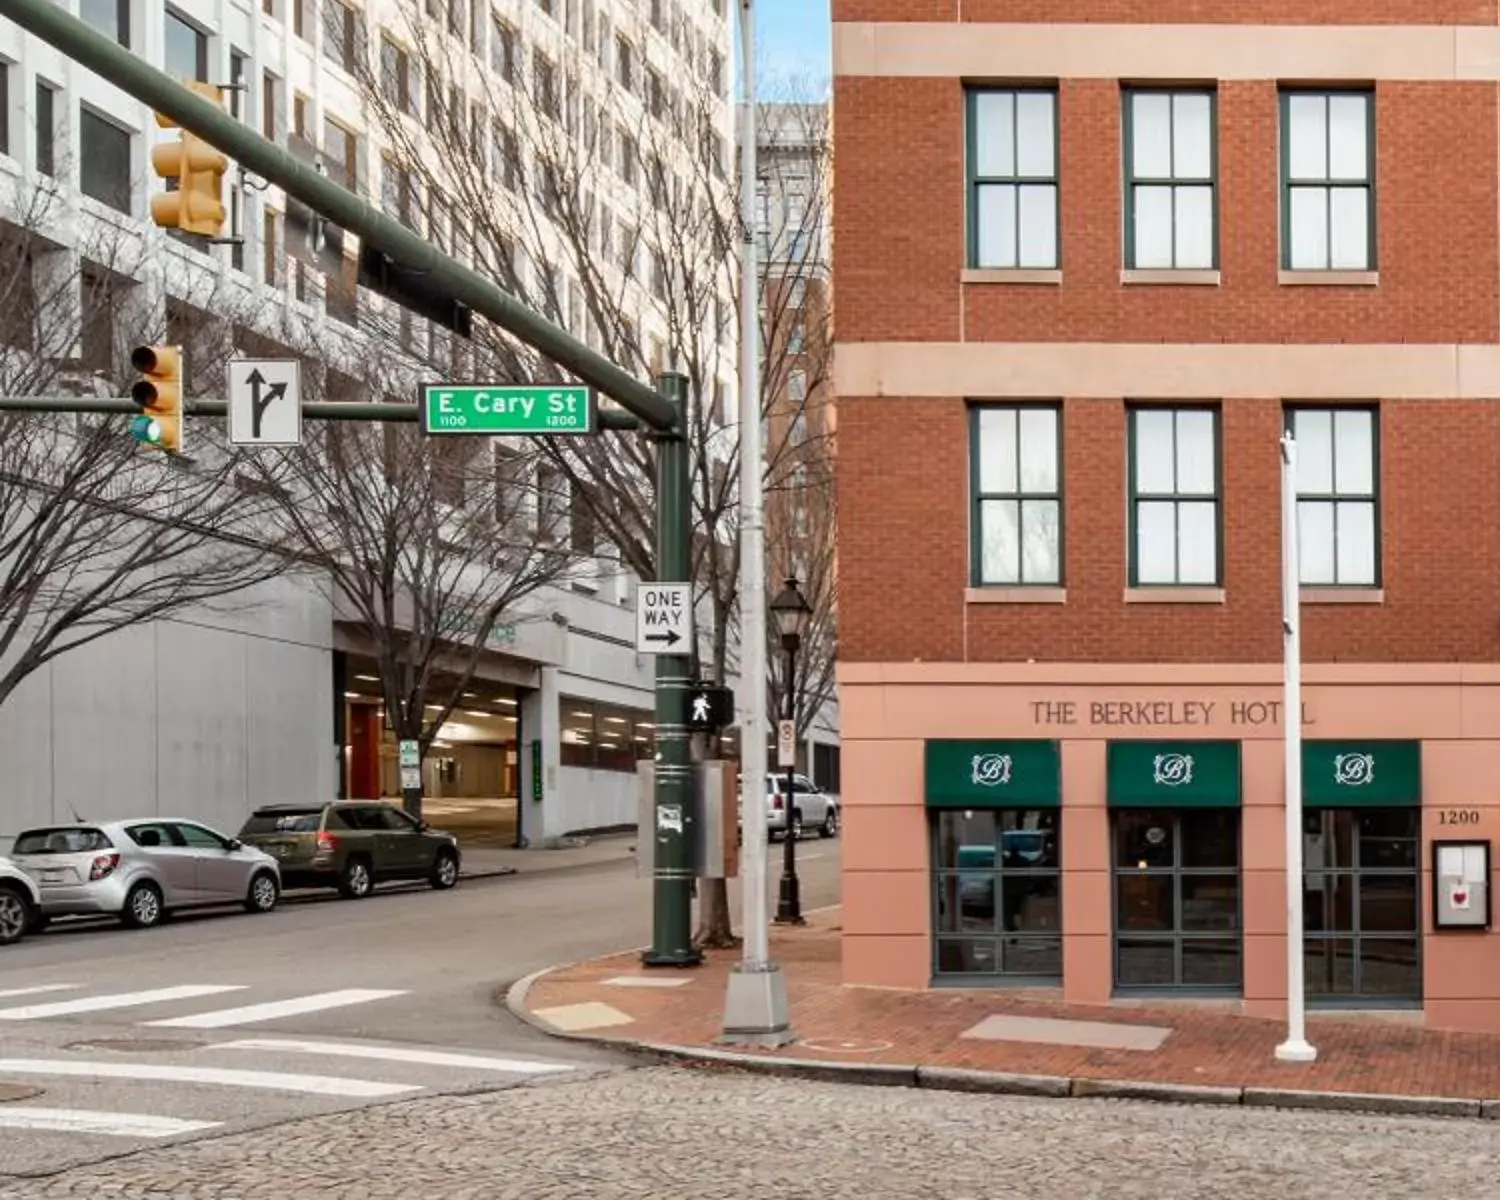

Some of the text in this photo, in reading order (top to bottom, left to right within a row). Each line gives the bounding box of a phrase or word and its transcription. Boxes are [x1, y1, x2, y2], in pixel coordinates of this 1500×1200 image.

[439, 392, 577, 418] E. Cary St
[440, 415, 467, 426] 1100
[546, 415, 577, 426] 1200
[645, 591, 681, 607] ONE
[645, 610, 682, 625] WAY
[1031, 701, 1316, 725] THE BERKELEY HOTL
[1438, 810, 1480, 825] 1200
